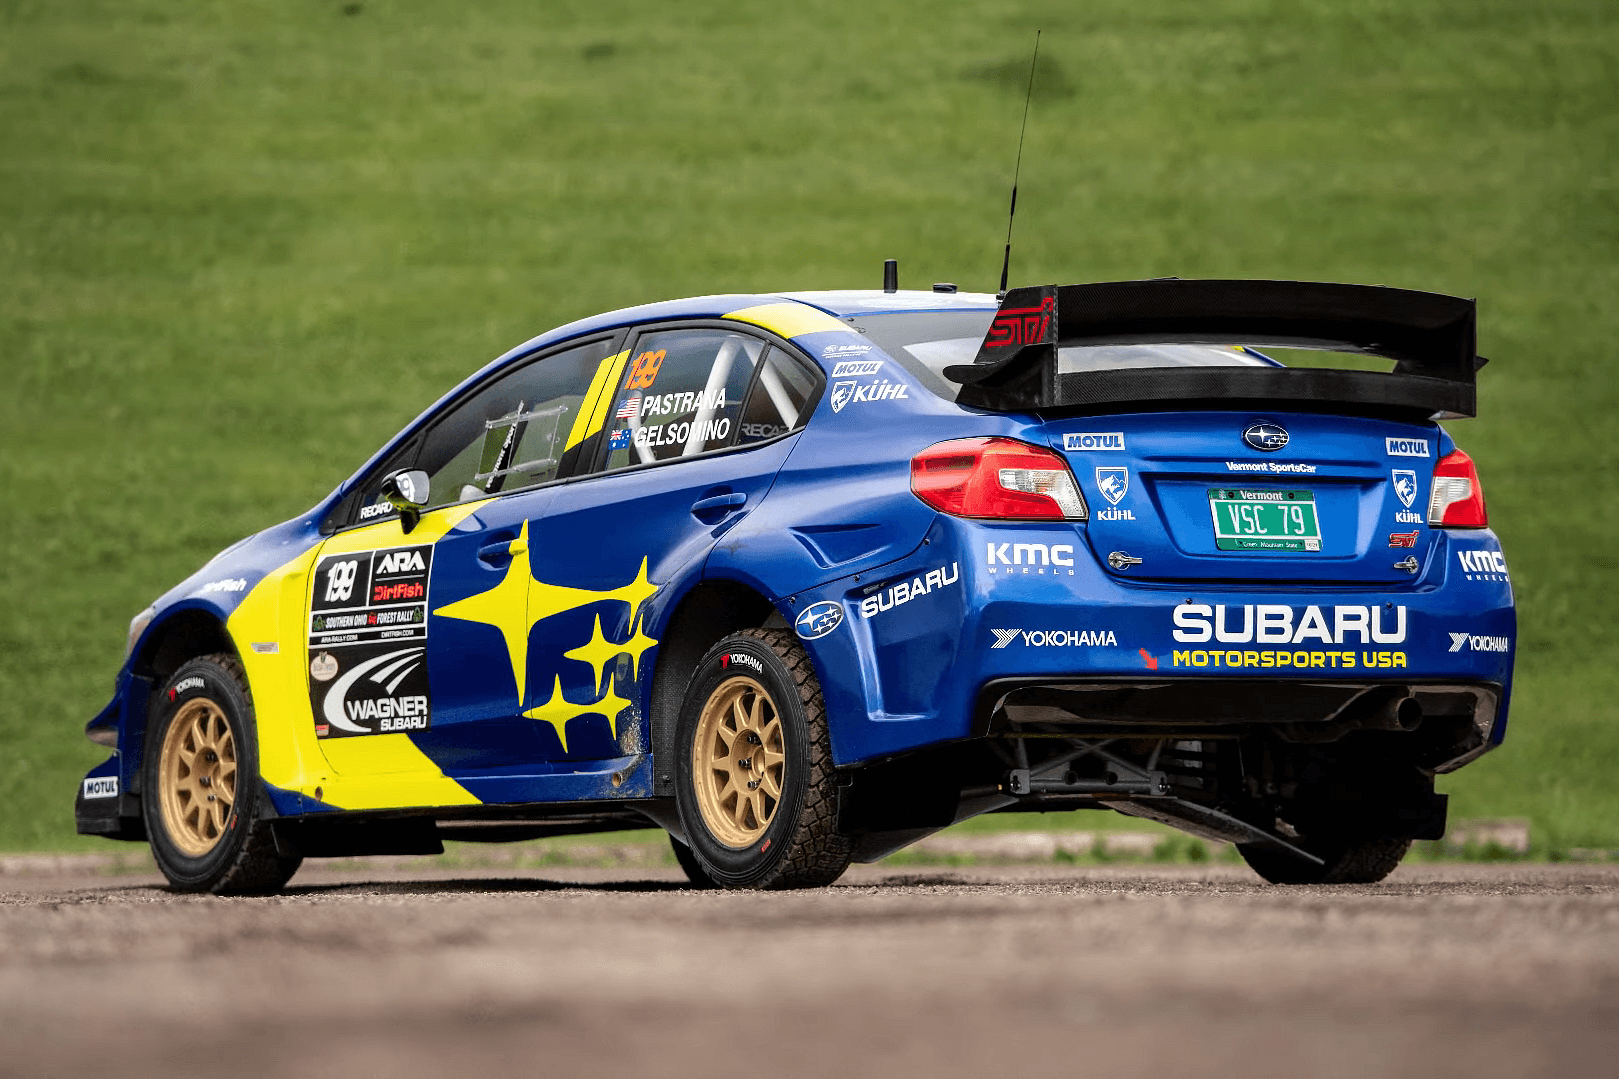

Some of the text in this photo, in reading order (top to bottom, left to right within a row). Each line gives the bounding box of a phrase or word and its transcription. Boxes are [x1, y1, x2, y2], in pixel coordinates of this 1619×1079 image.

[625, 350, 666, 389] 199
[835, 363, 878, 374] MOTUL
[853, 379, 908, 402] KÜHL
[641, 388, 726, 416] PASTRANA
[634, 418, 730, 447] GELSOMINO
[1068, 435, 1122, 448] MOTUL
[1389, 440, 1427, 454] MOTUL
[1226, 462, 1316, 473] Vermont SportsCar
[1240, 490, 1283, 500] Vermont
[360, 502, 393, 519] RECARO
[1097, 507, 1136, 520] KÜHL
[1395, 510, 1424, 523] KÜHL
[1228, 504, 1305, 535] VSC 79
[376, 551, 426, 574] ARA
[988, 567, 1074, 576] WHEELS
[325, 560, 358, 601] 199
[373, 582, 424, 600] DirtFish
[861, 562, 958, 618] SUBARU
[325, 614, 354, 628] SOUTHERN
[354, 613, 368, 625] OHIO
[377, 611, 397, 624] FOREST
[396, 610, 415, 622] RALLY
[1172, 604, 1407, 644] SUBARU
[1022, 630, 1118, 647] YOKOHAMA
[1469, 635, 1508, 652] YOKOHAMA
[730, 653, 763, 673] YOKOHAMA
[1173, 650, 1407, 668] MOTORSPORTS USA
[176, 677, 205, 694] YOKOHAMA
[346, 695, 428, 721] WAGNER
[380, 716, 428, 732] SUBARU
[86, 780, 116, 794] MOTUL
